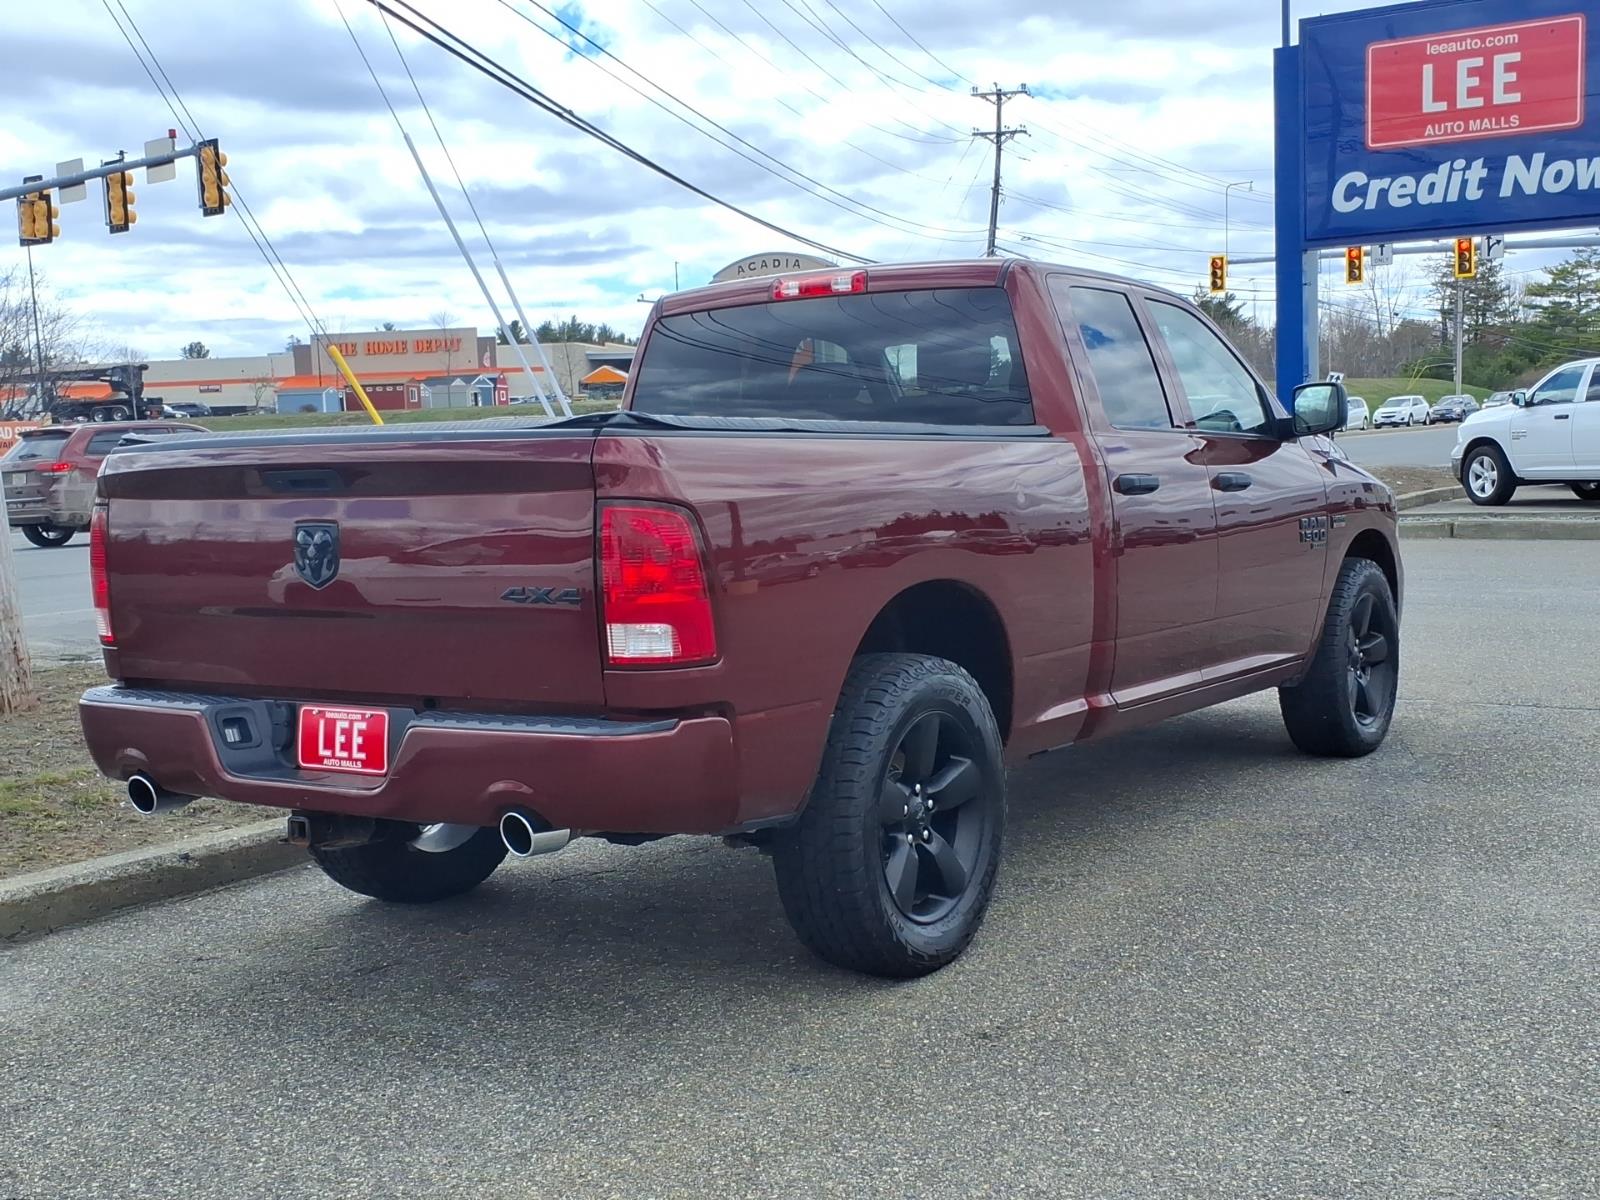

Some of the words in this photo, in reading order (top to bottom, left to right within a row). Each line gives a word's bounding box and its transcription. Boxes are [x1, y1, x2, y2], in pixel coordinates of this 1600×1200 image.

[1426, 33, 1519, 55] leeauto.com
[1422, 52, 1521, 113] LEE
[1424, 121, 1465, 137] AUTO
[1469, 114, 1520, 131] MALLS
[1331, 157, 1488, 213] Credit
[737, 258, 801, 275] ACADIA
[365, 340, 408, 356] HOME
[413, 338, 462, 353] DEPOT
[318, 718, 367, 760] LEE
[323, 758, 340, 767] AUTO
[340, 760, 362, 769] MALLS
